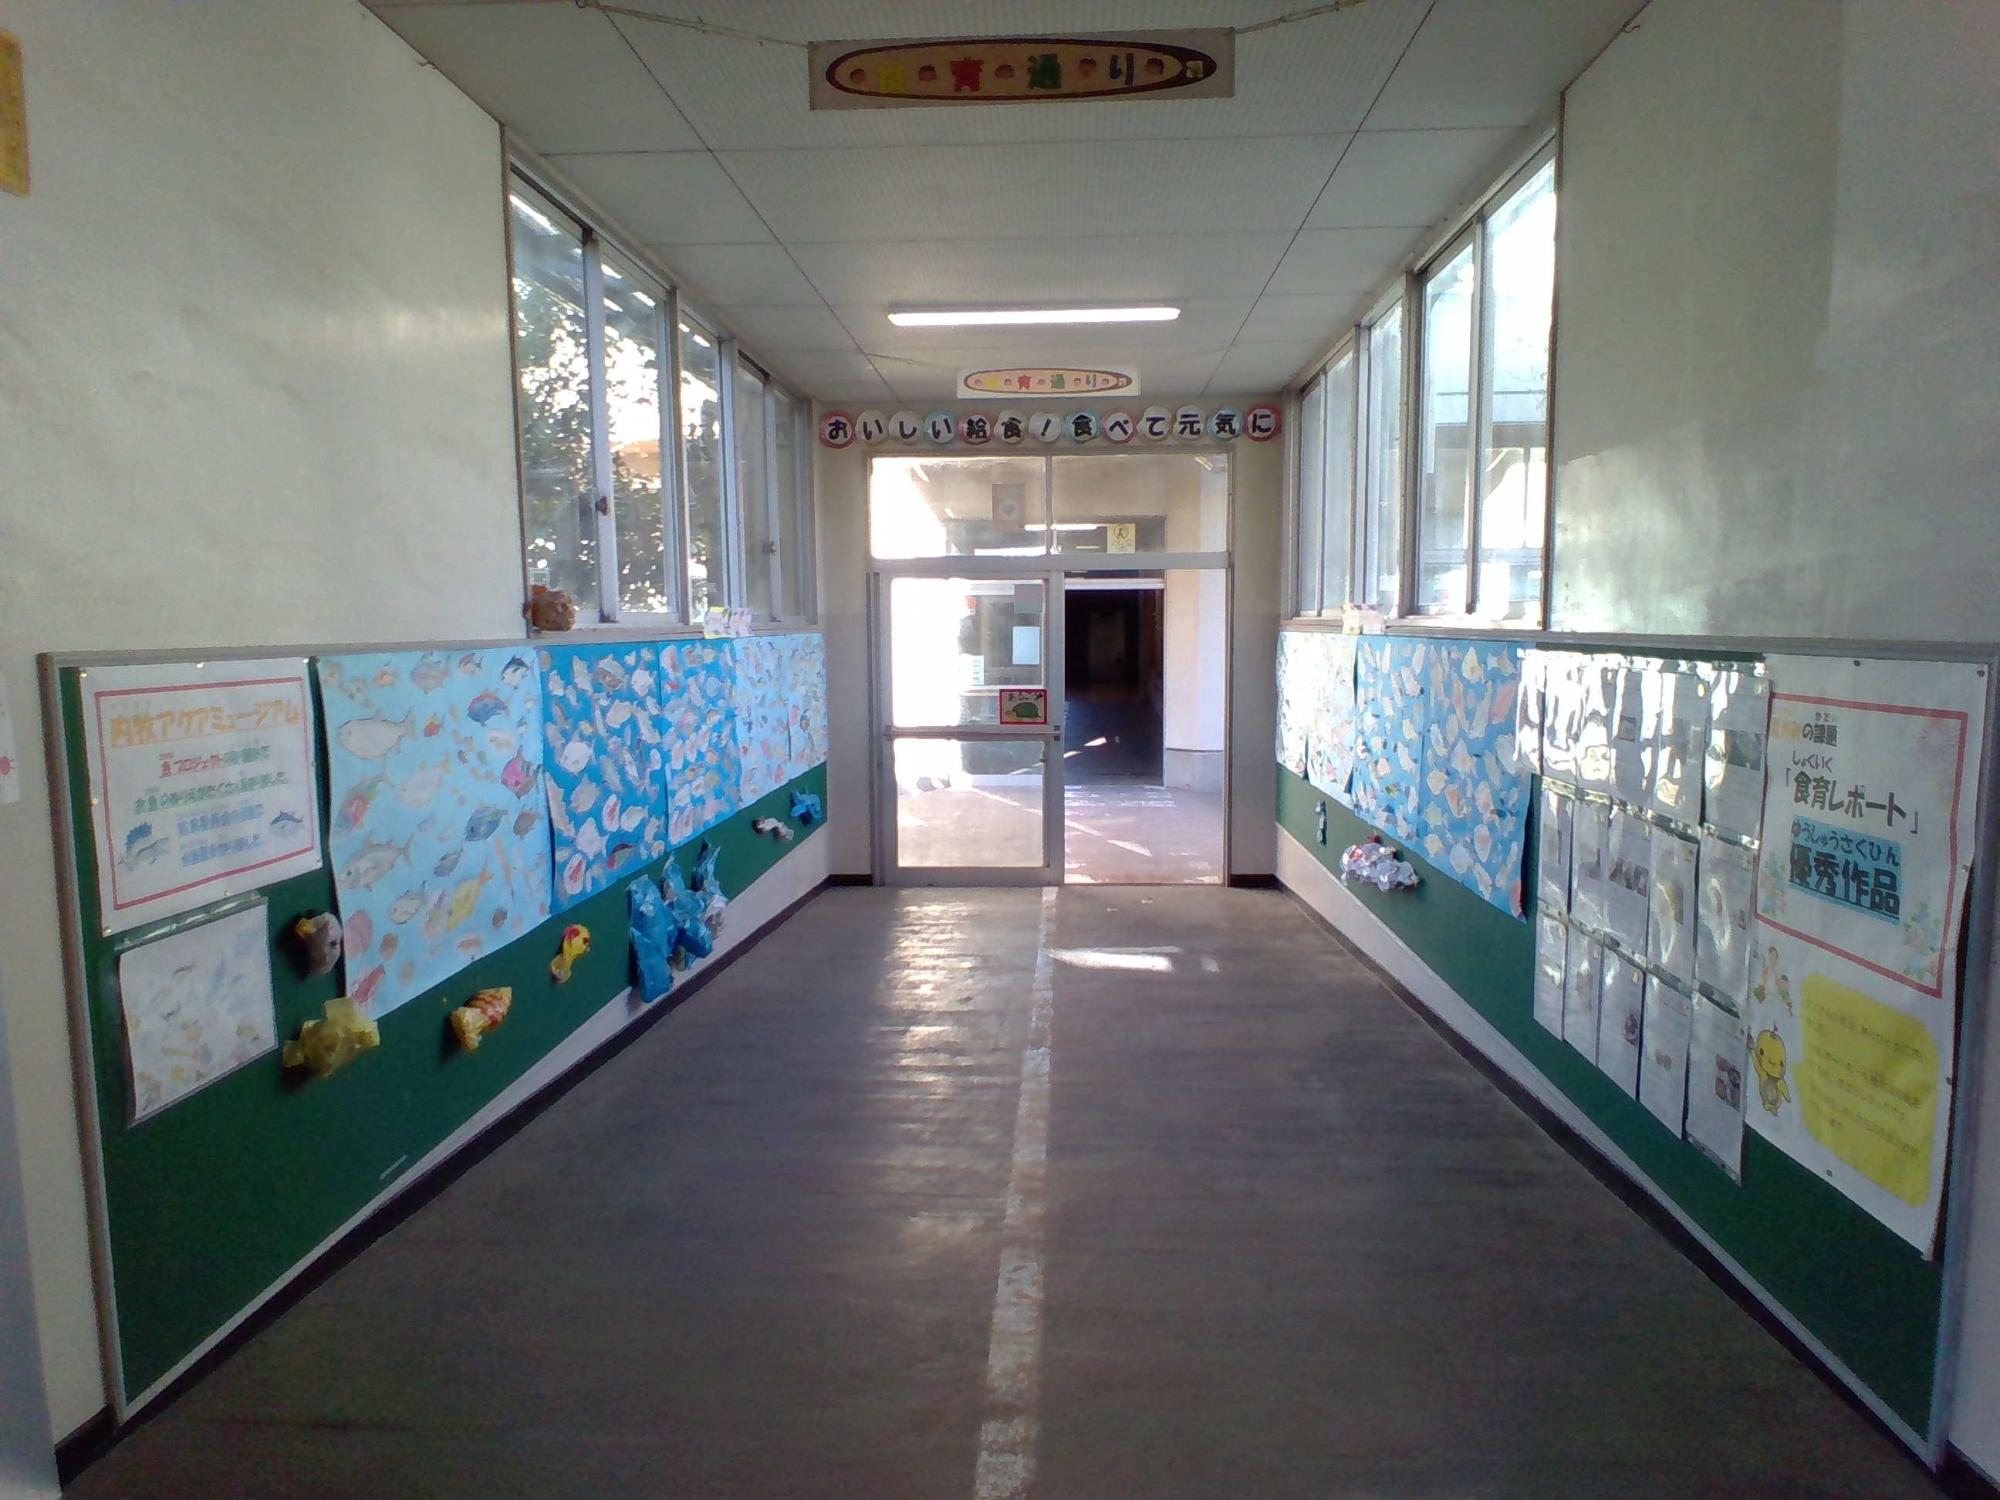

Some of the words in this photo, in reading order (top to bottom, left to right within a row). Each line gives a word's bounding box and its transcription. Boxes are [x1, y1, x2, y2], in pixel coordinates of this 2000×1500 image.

[1786, 768, 1919, 834] 「食育レポート」
